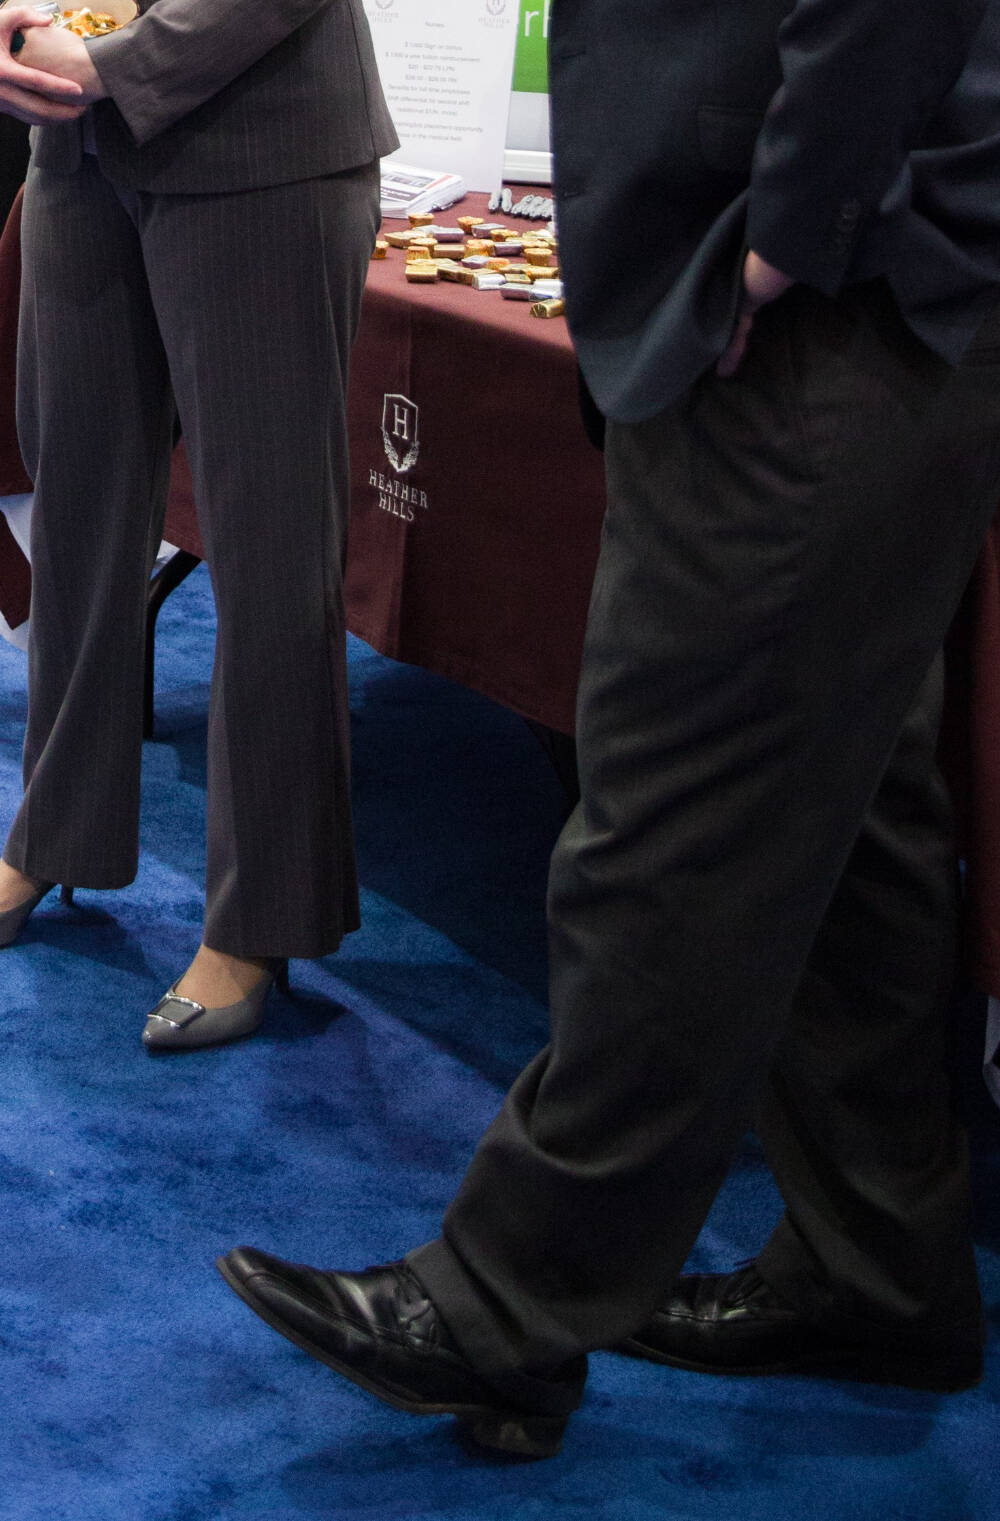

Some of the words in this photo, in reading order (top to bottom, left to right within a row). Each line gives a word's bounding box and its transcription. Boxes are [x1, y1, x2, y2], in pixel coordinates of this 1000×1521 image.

[392, 402, 408, 441] H
[369, 468, 429, 510] HEATHER
[378, 491, 415, 523] HILLS
